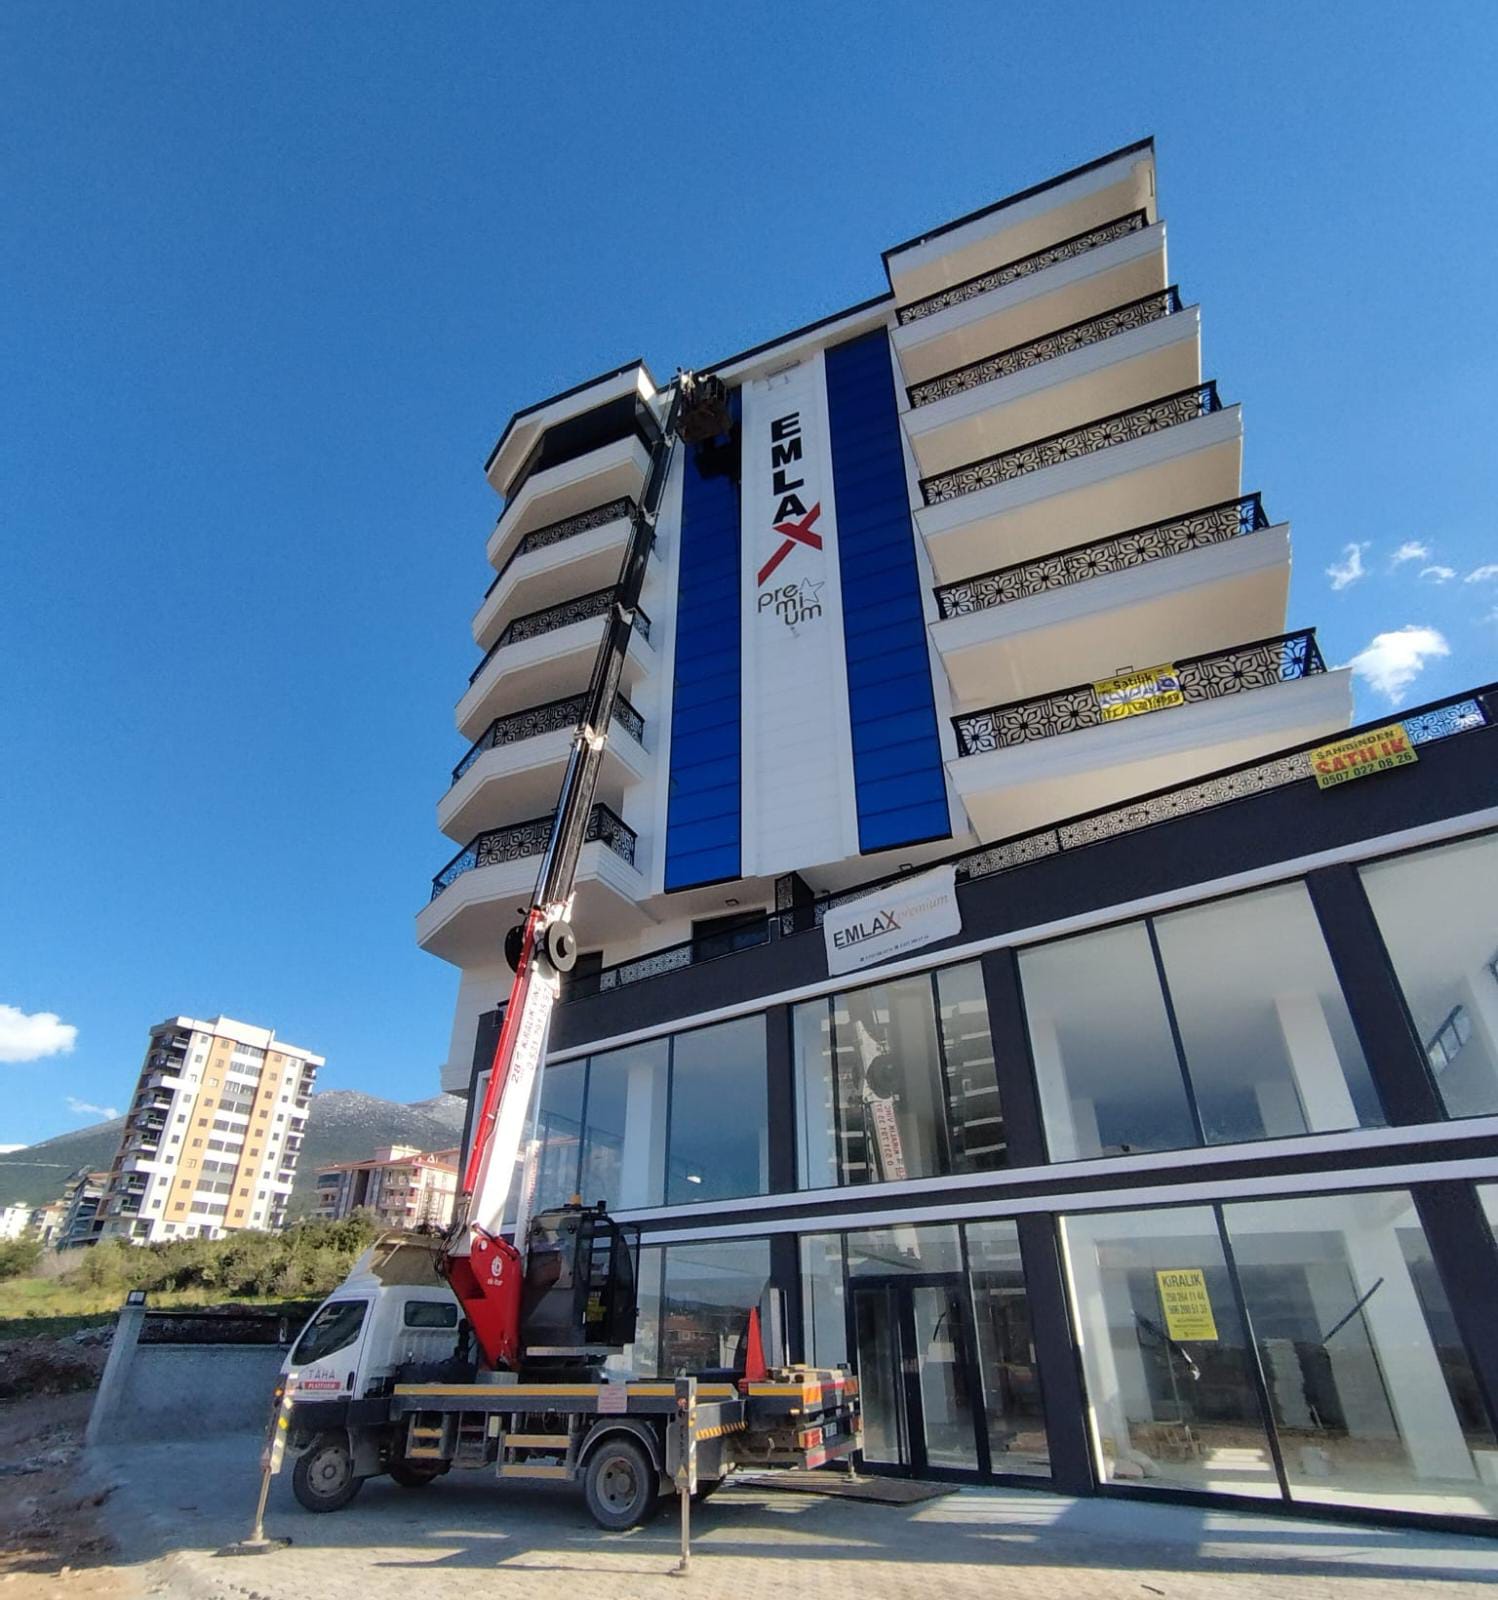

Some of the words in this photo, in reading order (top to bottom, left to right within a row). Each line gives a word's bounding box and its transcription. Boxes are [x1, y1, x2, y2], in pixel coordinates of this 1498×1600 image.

[758, 411, 823, 588] EMLAX
[1322, 771, 1350, 786] 0507
[1353, 763, 1375, 777] 022
[1378, 756, 1394, 769] 08
[1396, 751, 1412, 764] 26
[833, 910, 901, 948] EMLAX
